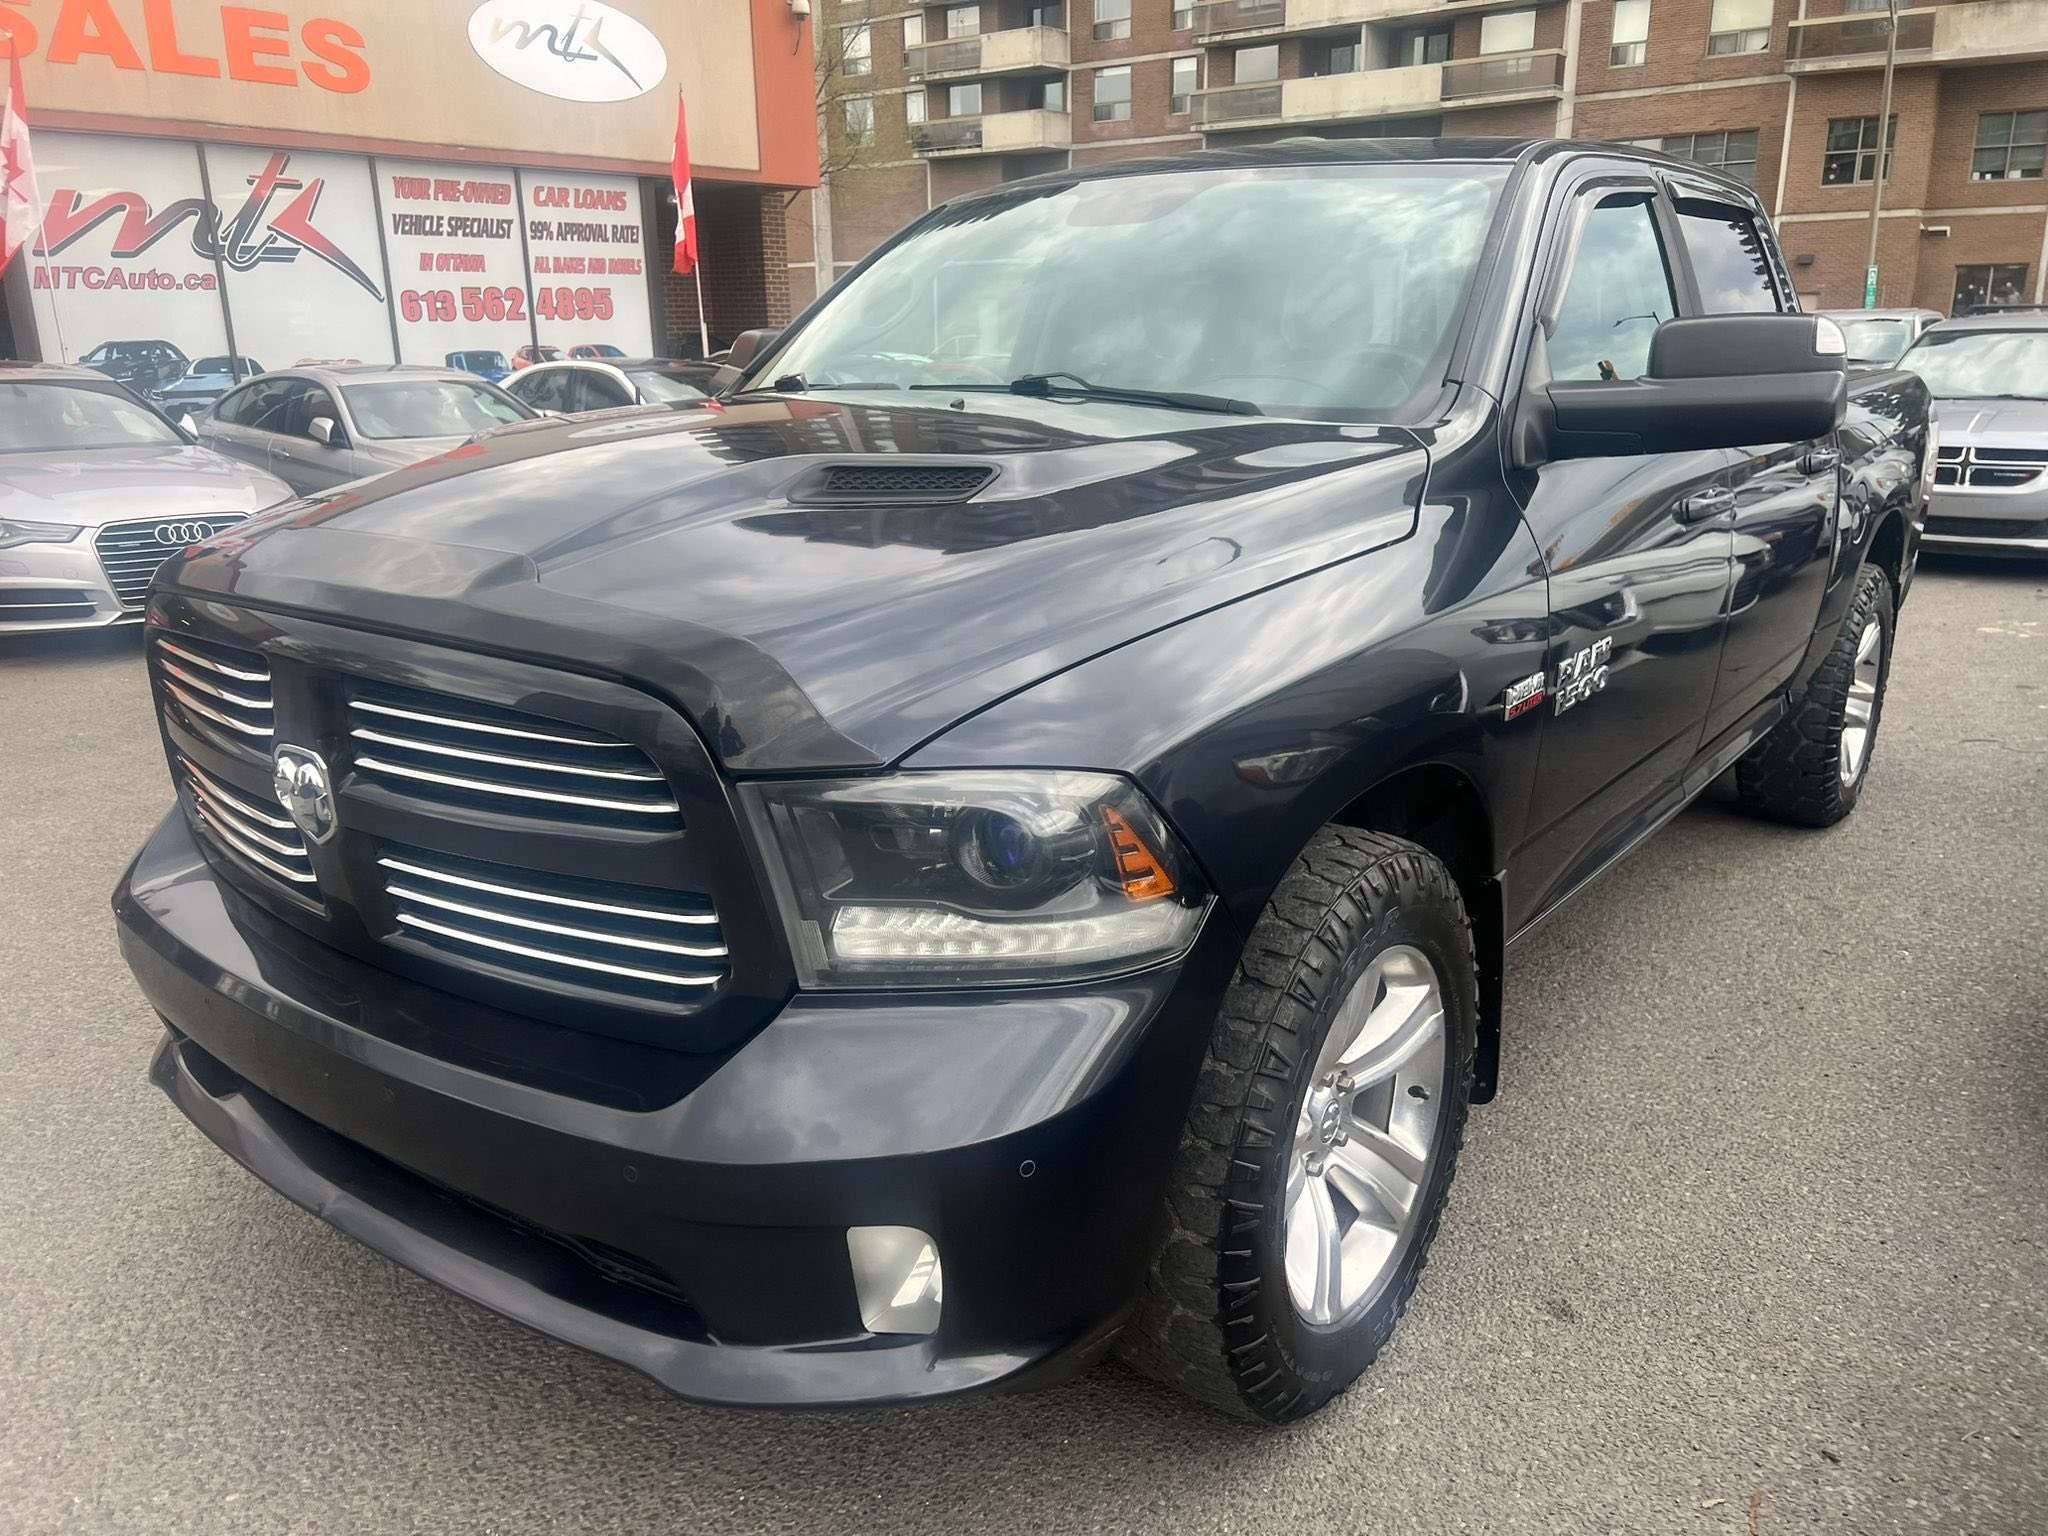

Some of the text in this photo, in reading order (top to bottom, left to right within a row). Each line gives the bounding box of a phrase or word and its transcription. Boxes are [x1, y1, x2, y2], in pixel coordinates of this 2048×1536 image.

[392, 176, 431, 200] YOUR
[533, 186, 627, 211] CAR LOANS
[392, 213, 513, 239] VEHICLE SPECIALIST
[530, 221, 554, 241] 99%
[556, 222, 609, 243] APPROVAL
[33, 266, 217, 290] MTCAuto.ca
[401, 287, 614, 322] 613 562 4895
